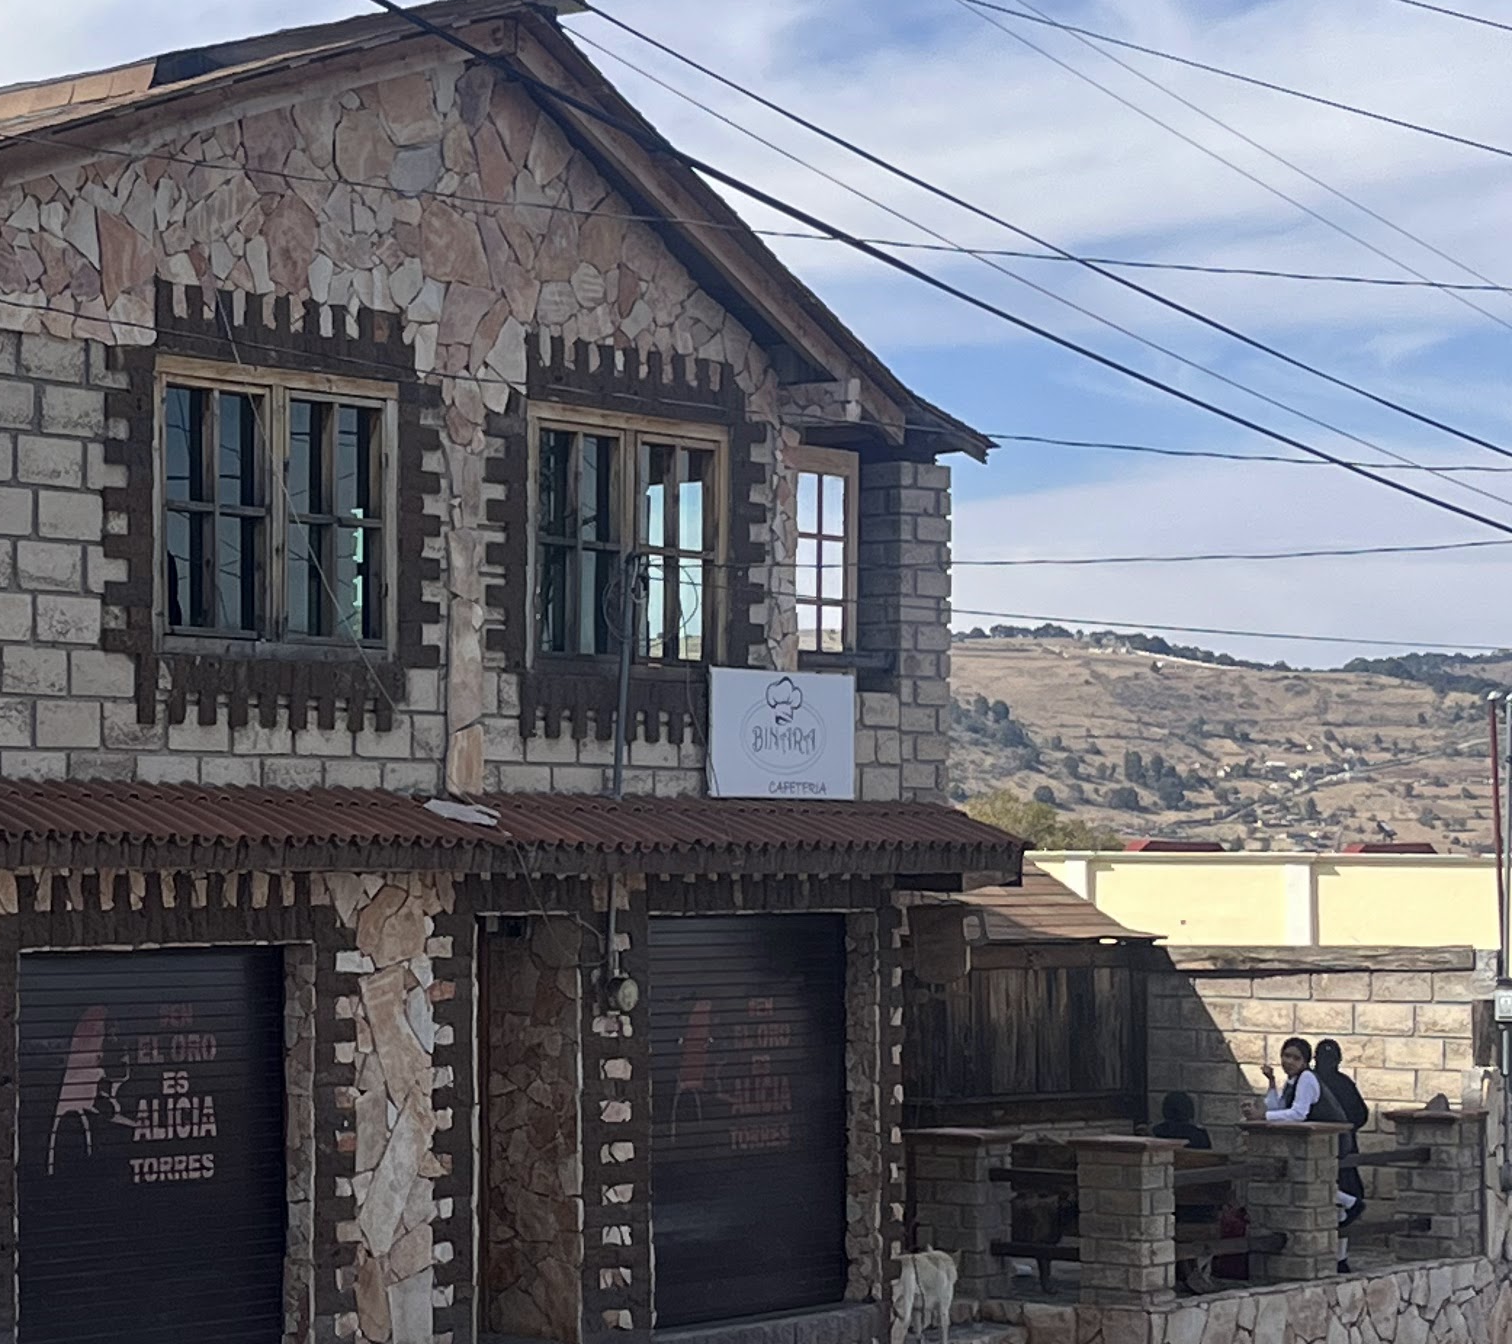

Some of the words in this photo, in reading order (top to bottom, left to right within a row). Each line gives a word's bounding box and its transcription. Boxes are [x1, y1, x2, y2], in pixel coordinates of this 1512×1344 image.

[752, 725, 816, 755] BINARA
[768, 780, 827, 795] CAFETERIA
[138, 1036, 164, 1064] EL
[171, 1033, 217, 1062] ORO
[163, 1071, 189, 1094] ES
[133, 1096, 217, 1142] ALICIA
[129, 1154, 215, 1183] TORRES
